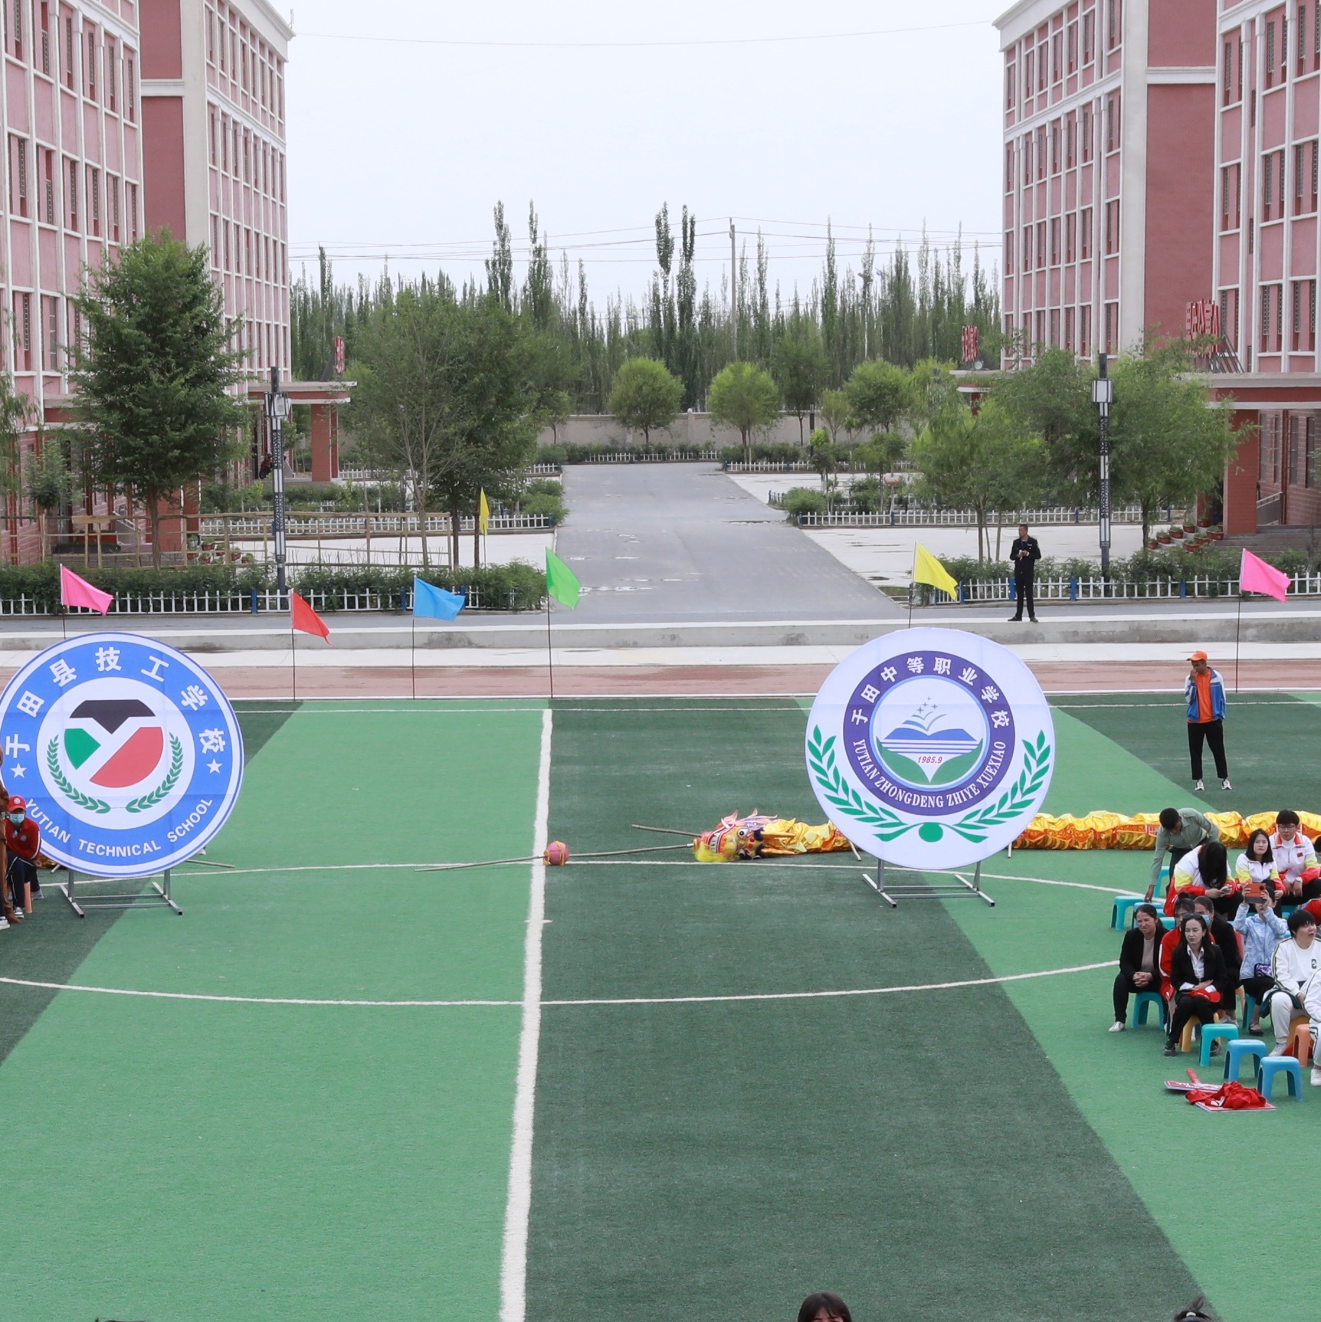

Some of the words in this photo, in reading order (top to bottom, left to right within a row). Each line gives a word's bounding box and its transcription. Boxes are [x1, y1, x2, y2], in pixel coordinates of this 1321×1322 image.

[5, 646, 226, 758] 于田县技工学校
[851, 656, 1010, 728] 于田中等职业学校
[853, 739, 881, 781] YUTIAN
[874, 776, 944, 808] ZHONGDENG
[946, 783, 981, 807] ZHIYE
[976, 741, 1007, 790] XUEXIAO
[917, 755, 943, 764] 1985.9
[25, 798, 71, 843] YUTIAN
[78, 839, 161, 857] TECHNICAL
[167, 797, 213, 843] SCHOOL
